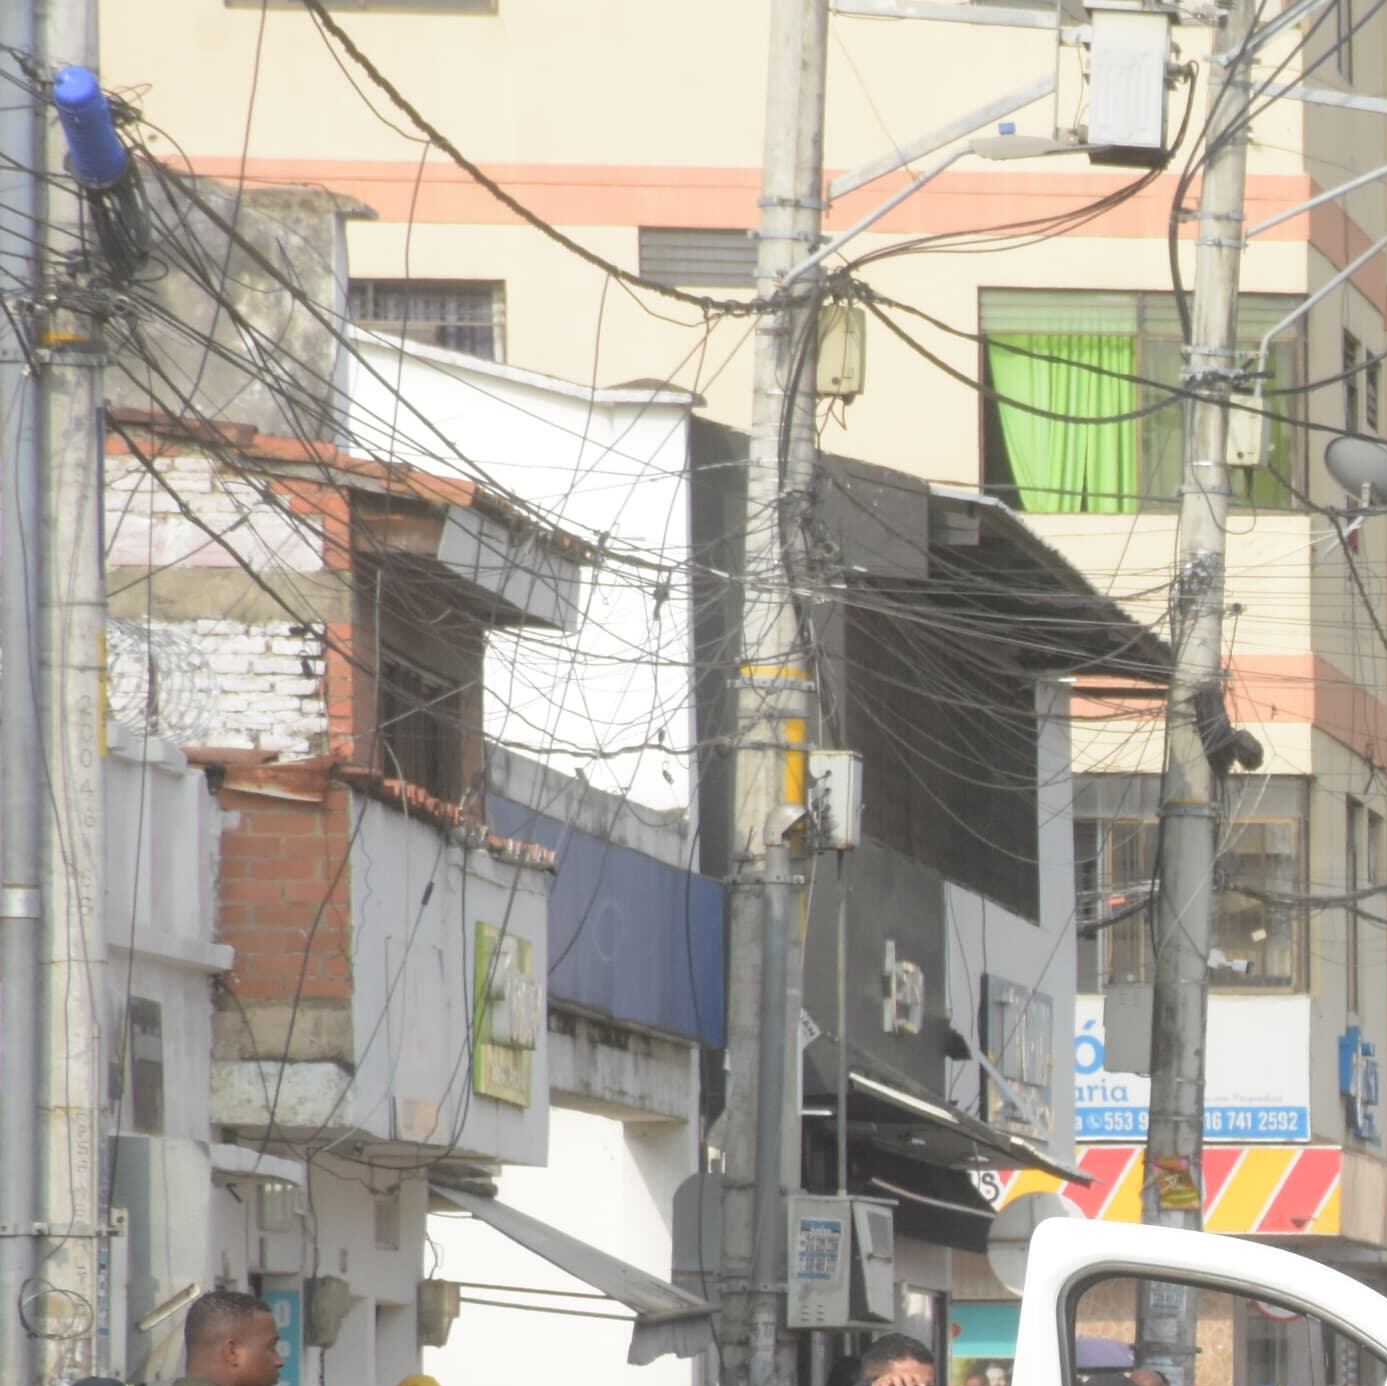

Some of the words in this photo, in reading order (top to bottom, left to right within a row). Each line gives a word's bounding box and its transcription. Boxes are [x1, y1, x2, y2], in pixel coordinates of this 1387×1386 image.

[1104, 1111, 1134, 1131] 553
[1227, 1111, 1252, 1130] 741
[1258, 1111, 1298, 1131] 2592
